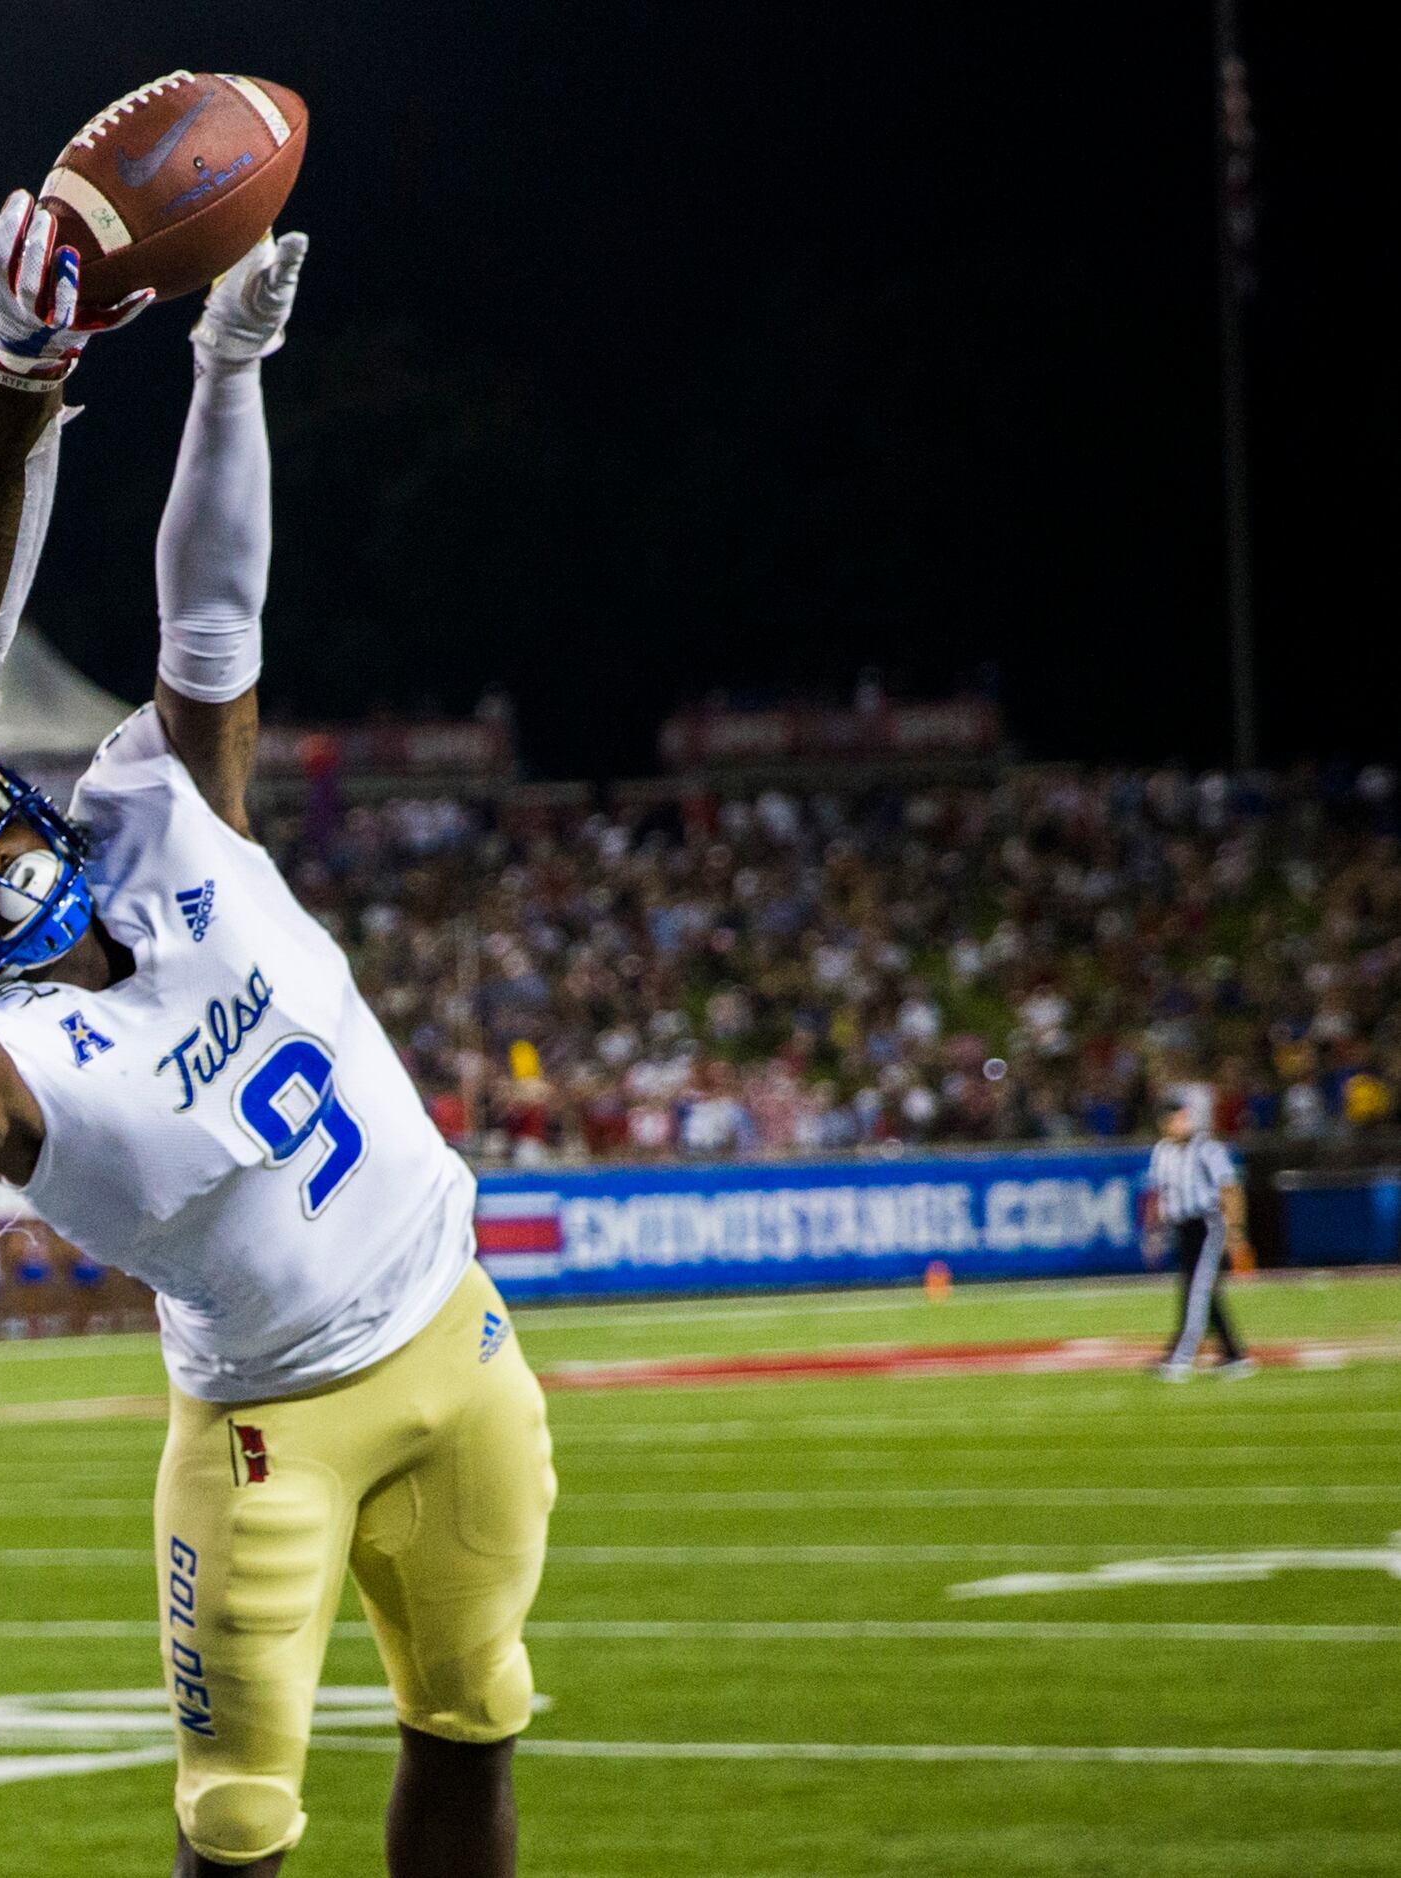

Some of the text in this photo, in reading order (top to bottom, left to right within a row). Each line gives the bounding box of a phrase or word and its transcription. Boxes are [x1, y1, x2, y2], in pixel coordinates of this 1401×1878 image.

[192, 879, 214, 943] adidas
[155, 963, 273, 1113] Tulsa
[231, 1032, 368, 1220] 9
[170, 1535, 216, 1738] GOLDEN
